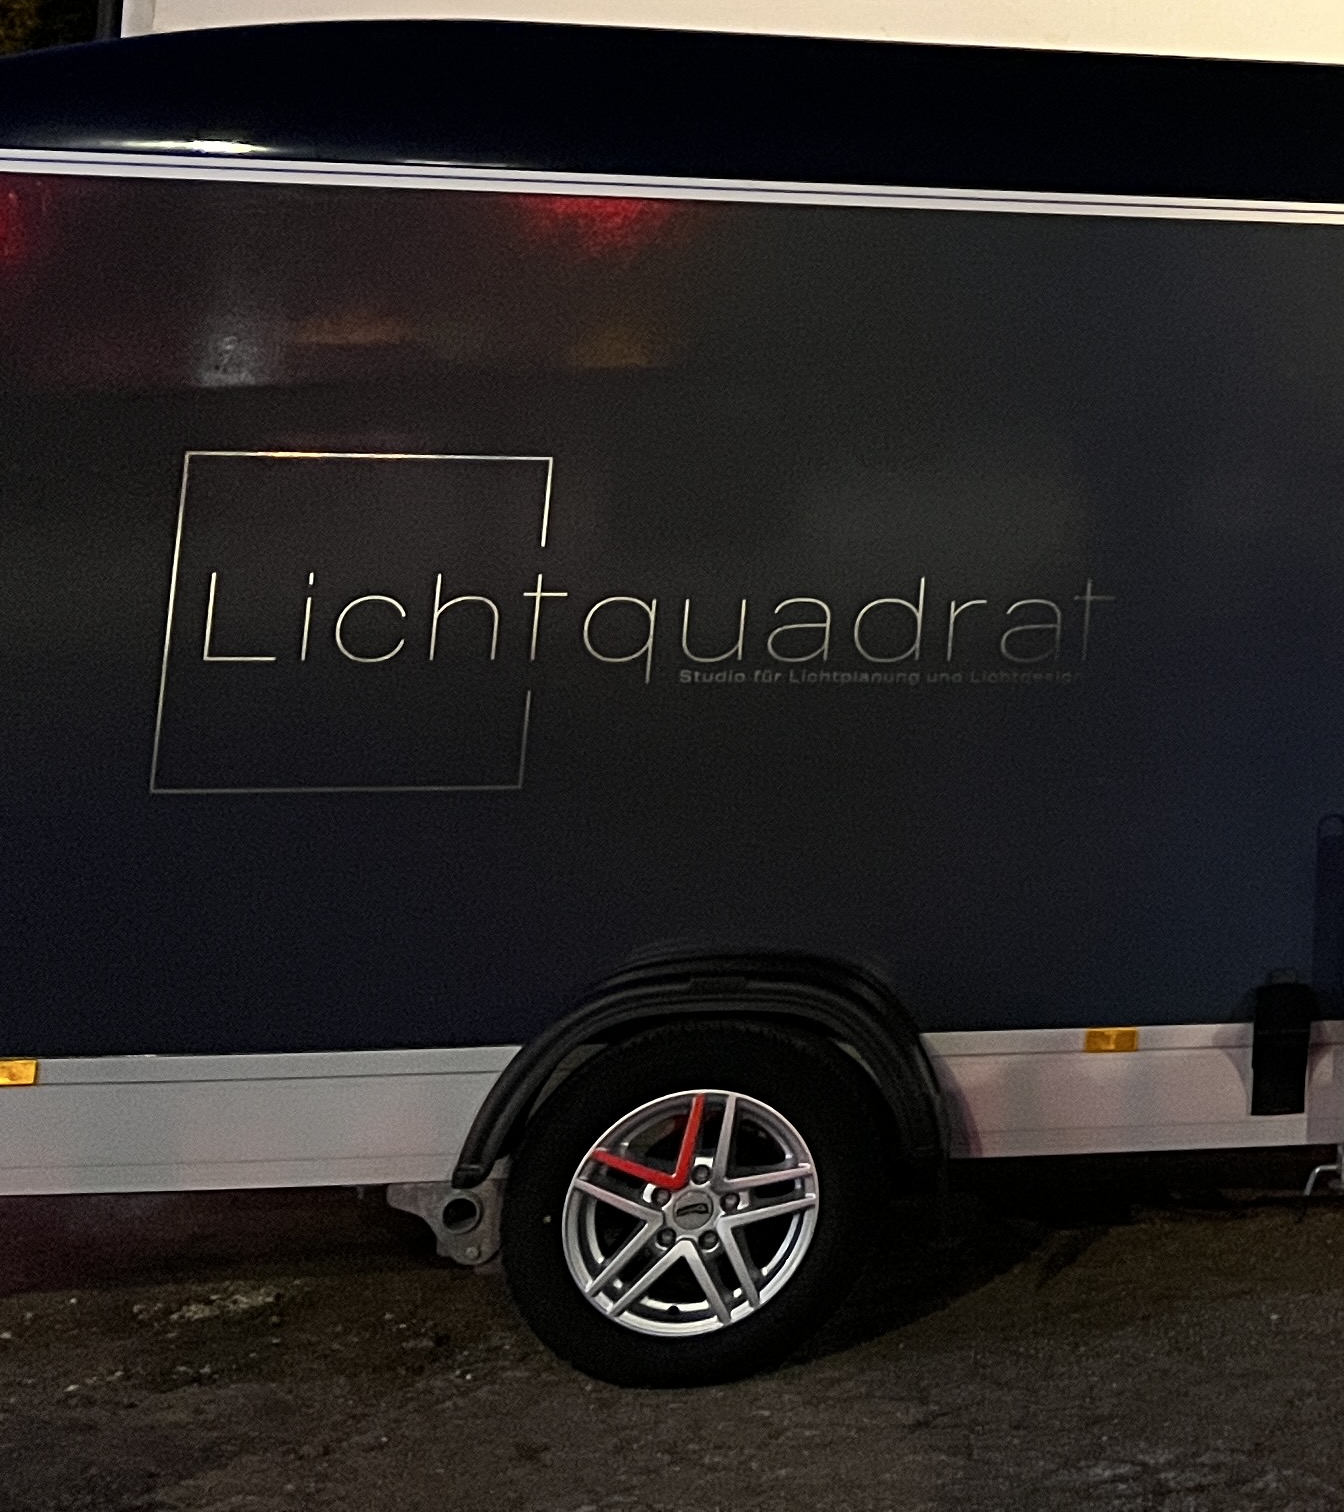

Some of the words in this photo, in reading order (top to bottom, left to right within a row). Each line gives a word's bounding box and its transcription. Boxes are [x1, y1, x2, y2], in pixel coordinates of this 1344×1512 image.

[202, 571, 1117, 684] Lichtquadrat
[678, 668, 747, 684] Studio
[753, 668, 783, 684] für
[788, 668, 920, 687] Lichtplanung
